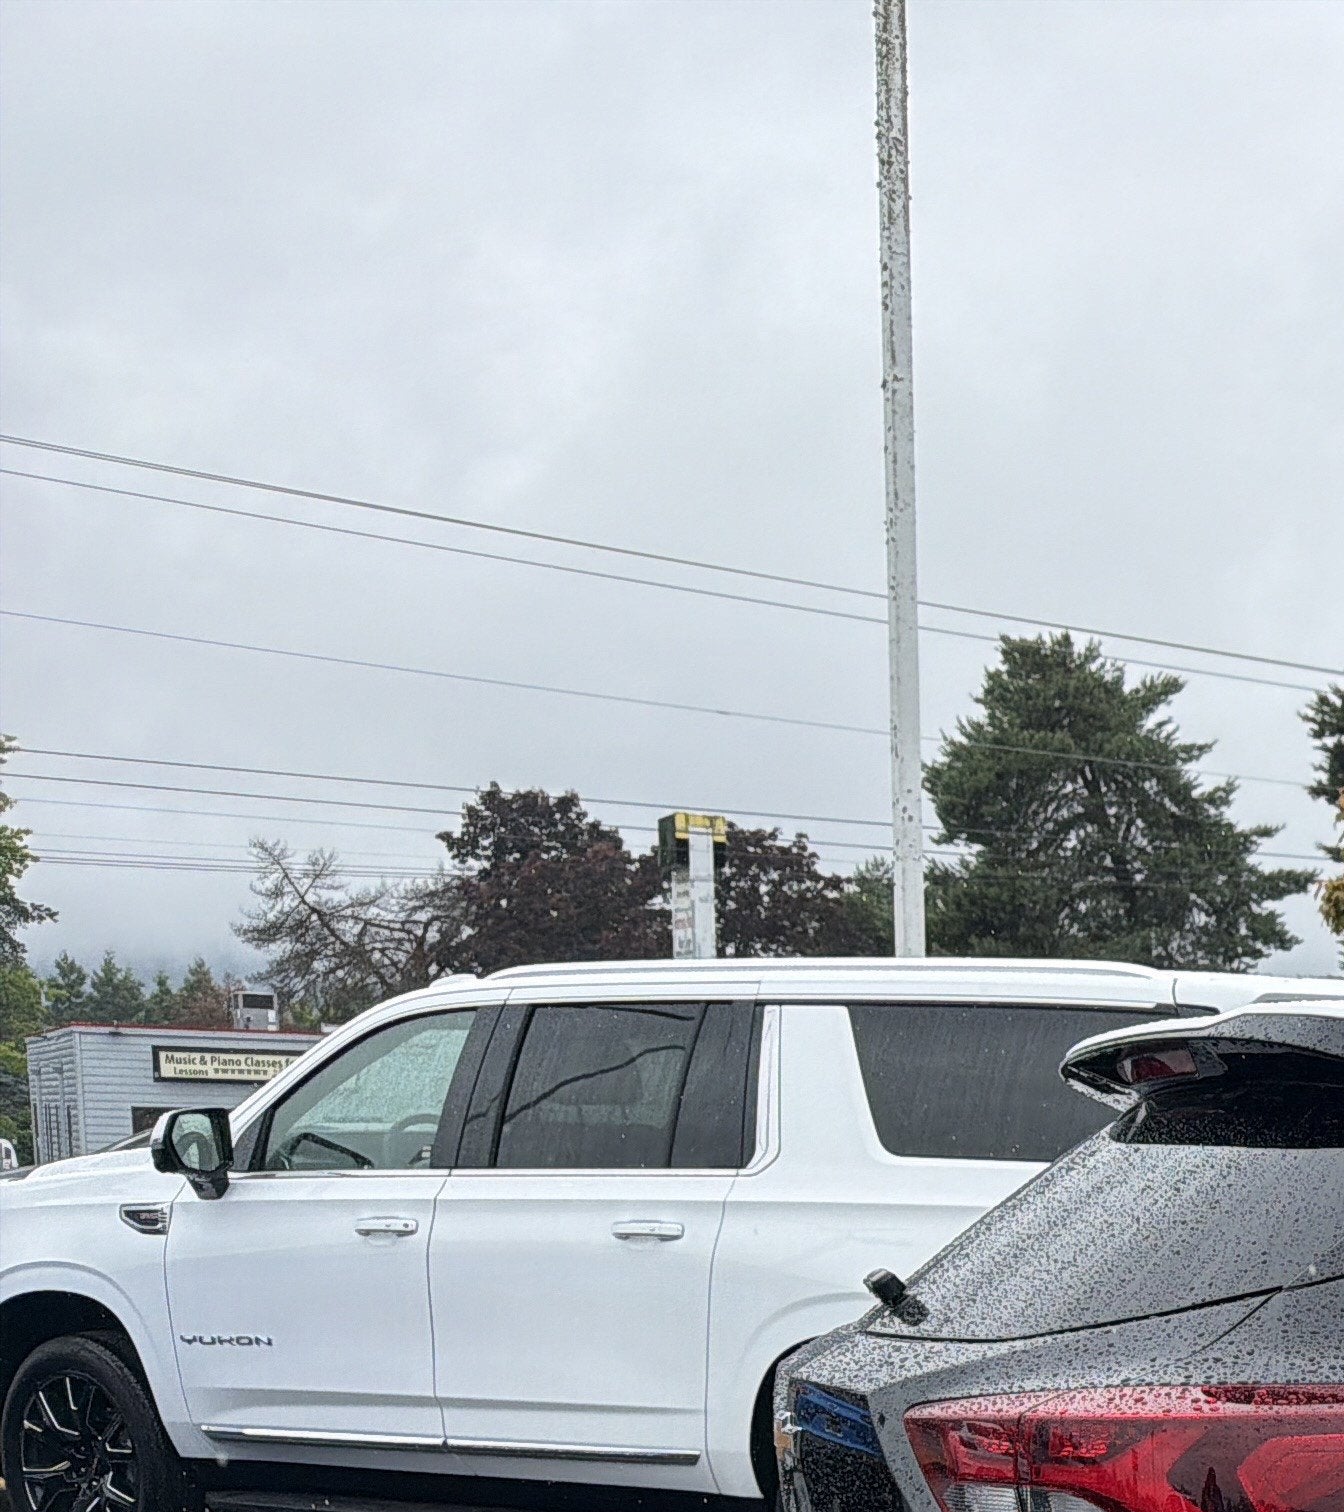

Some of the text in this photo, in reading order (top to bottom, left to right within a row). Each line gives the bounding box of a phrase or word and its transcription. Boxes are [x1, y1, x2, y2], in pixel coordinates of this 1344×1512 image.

[164, 1053, 197, 1065] Music
[199, 1055, 208, 1066] &
[210, 1056, 242, 1067] Piano
[244, 1056, 283, 1069] Classes
[173, 1066, 209, 1076] Lessons
[180, 1334, 273, 1347] YUKON
